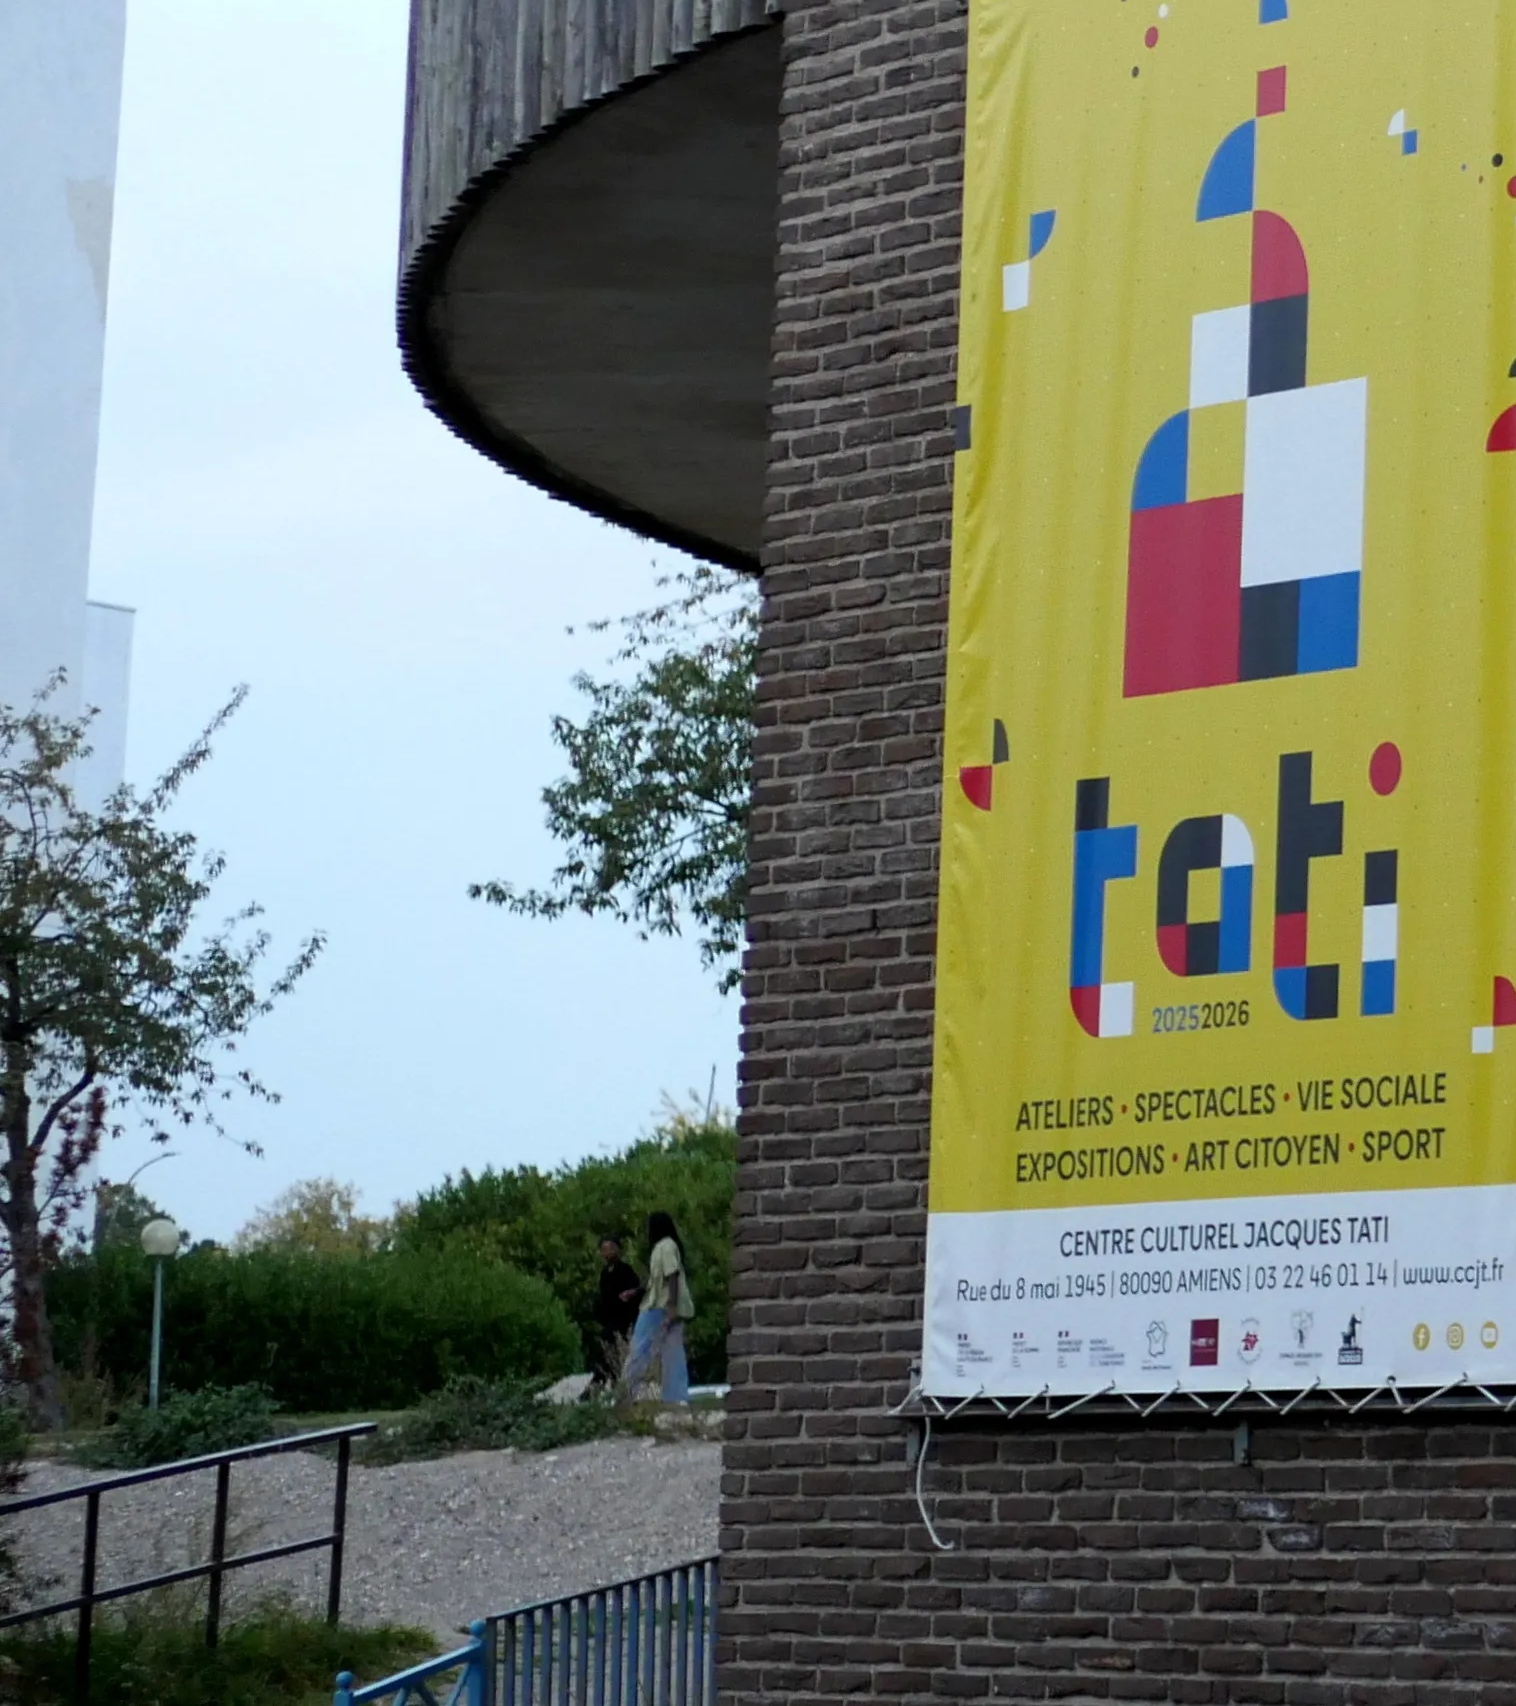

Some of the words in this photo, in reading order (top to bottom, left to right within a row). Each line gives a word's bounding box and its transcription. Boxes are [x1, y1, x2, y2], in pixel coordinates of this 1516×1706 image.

[1069, 741, 1402, 1038] tati
[1015, 1094, 1115, 1132] ATELIERS
[1134, 1082, 1276, 1124] SPECTACLES
[1296, 1079, 1334, 1112] VIE
[1340, 1072, 1447, 1110] SOCIALE
[1015, 1143, 1165, 1183] EXPOSITIONS
[1184, 1140, 1230, 1173] ART
[1234, 1132, 1340, 1170] CITOYEN
[1362, 1127, 1446, 1163] SPORT
[1059, 1227, 1136, 1258] CENTRE
[1140, 1221, 1239, 1253] CULTUREL
[1243, 1217, 1342, 1250] JACQUES
[1347, 1215, 1390, 1244] TATI
[956, 1278, 987, 1302] Rue
[990, 1278, 1011, 1300] du
[1015, 1277, 1026, 1300] 8
[1030, 1274, 1060, 1299] mai
[1064, 1273, 1107, 1298] 1945
[1119, 1269, 1173, 1296] 80090
[1176, 1266, 1243, 1293] AMIENS
[1255, 1264, 1278, 1291] 03
[1282, 1264, 1305, 1289] 22
[1309, 1263, 1333, 1288] 46
[1337, 1262, 1359, 1287] 01
[1365, 1261, 1389, 1286] 14
[1402, 1256, 1505, 1290] www.ccjt.fr
